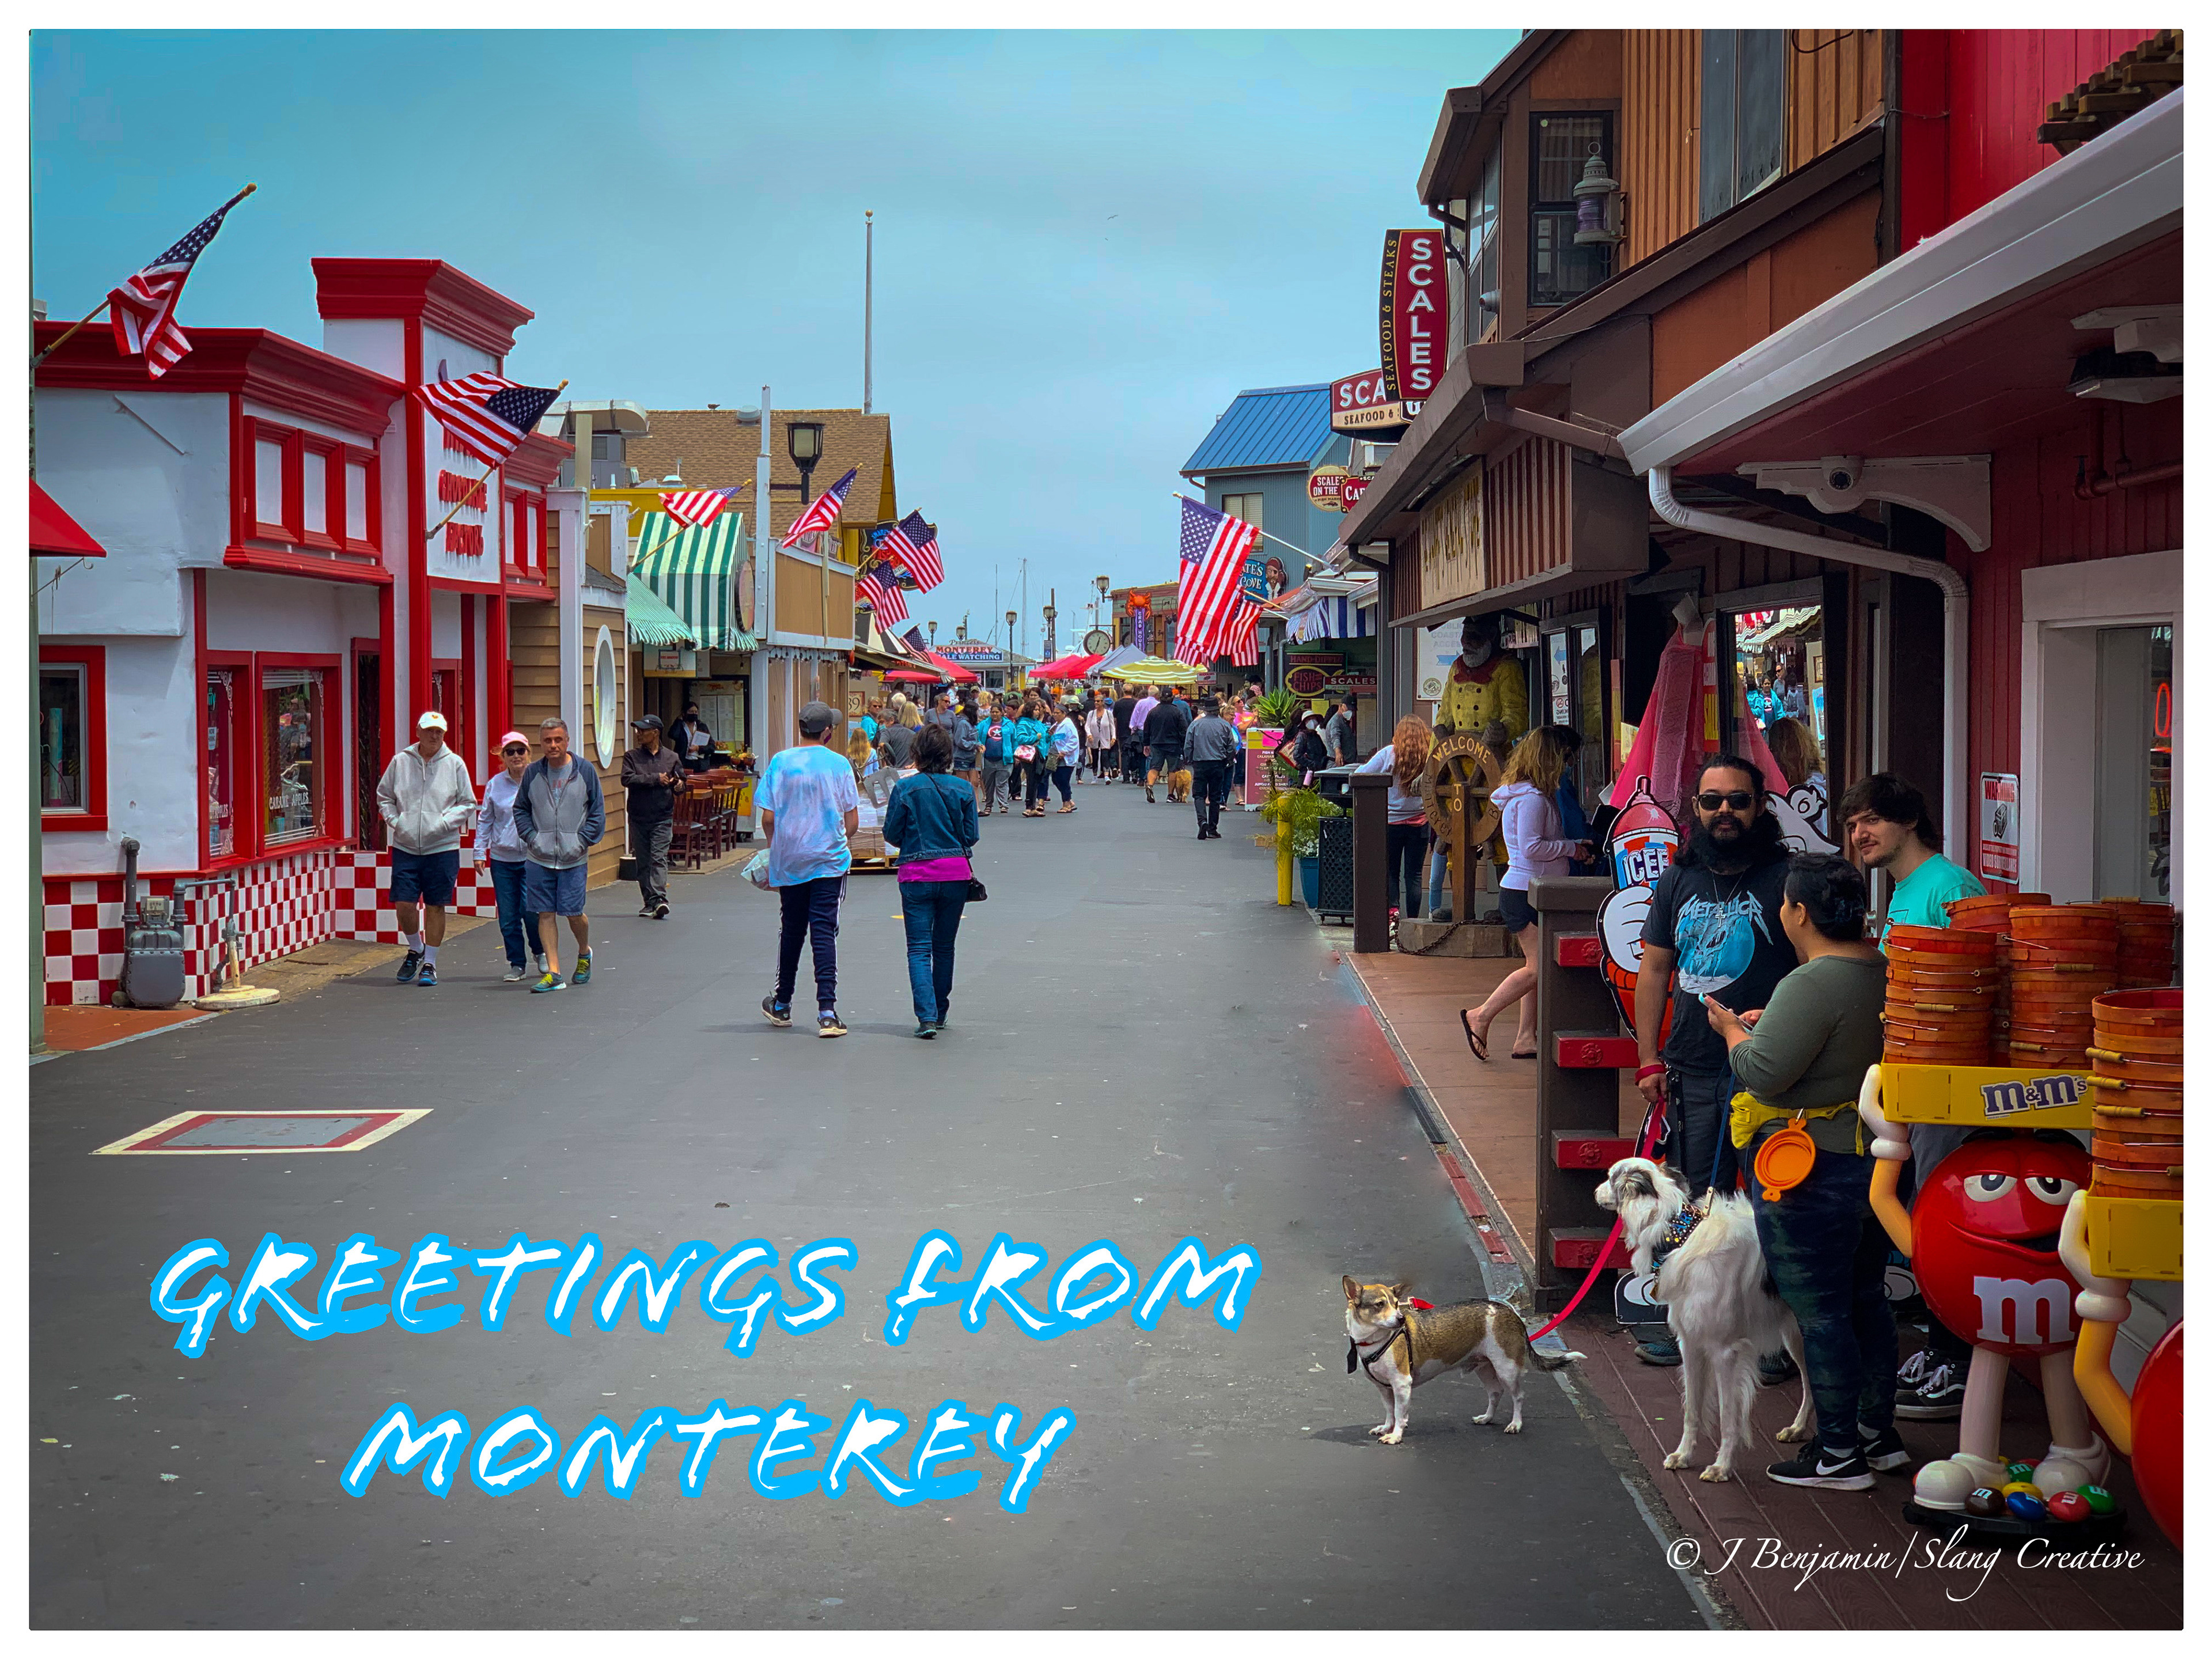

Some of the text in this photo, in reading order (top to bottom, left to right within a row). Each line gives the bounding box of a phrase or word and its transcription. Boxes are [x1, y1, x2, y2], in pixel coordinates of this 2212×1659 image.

[1383, 239, 1396, 297] STEAKS
[1407, 238, 1435, 391] SCALES
[1382, 320, 1396, 391] SEAFOOD
[1339, 377, 1387, 408] SCA
[1344, 410, 1385, 425] SEAFOOD
[1313, 487, 1338, 496] ON THE
[1346, 486, 1365, 501] CAF
[1240, 577, 1262, 590] COVE
[1293, 681, 1322, 691] CHIPS
[1294, 672, 1315, 681] FISH
[1433, 736, 1491, 764] WELCOME
[291, 791, 309, 806] APPLES
[1453, 783, 1462, 812] TO
[1984, 781, 2015, 802] WARNING
[1623, 848, 1669, 885] ICEE
[1676, 890, 1774, 945] METALLICA
[1974, 1275, 2075, 1344] m
